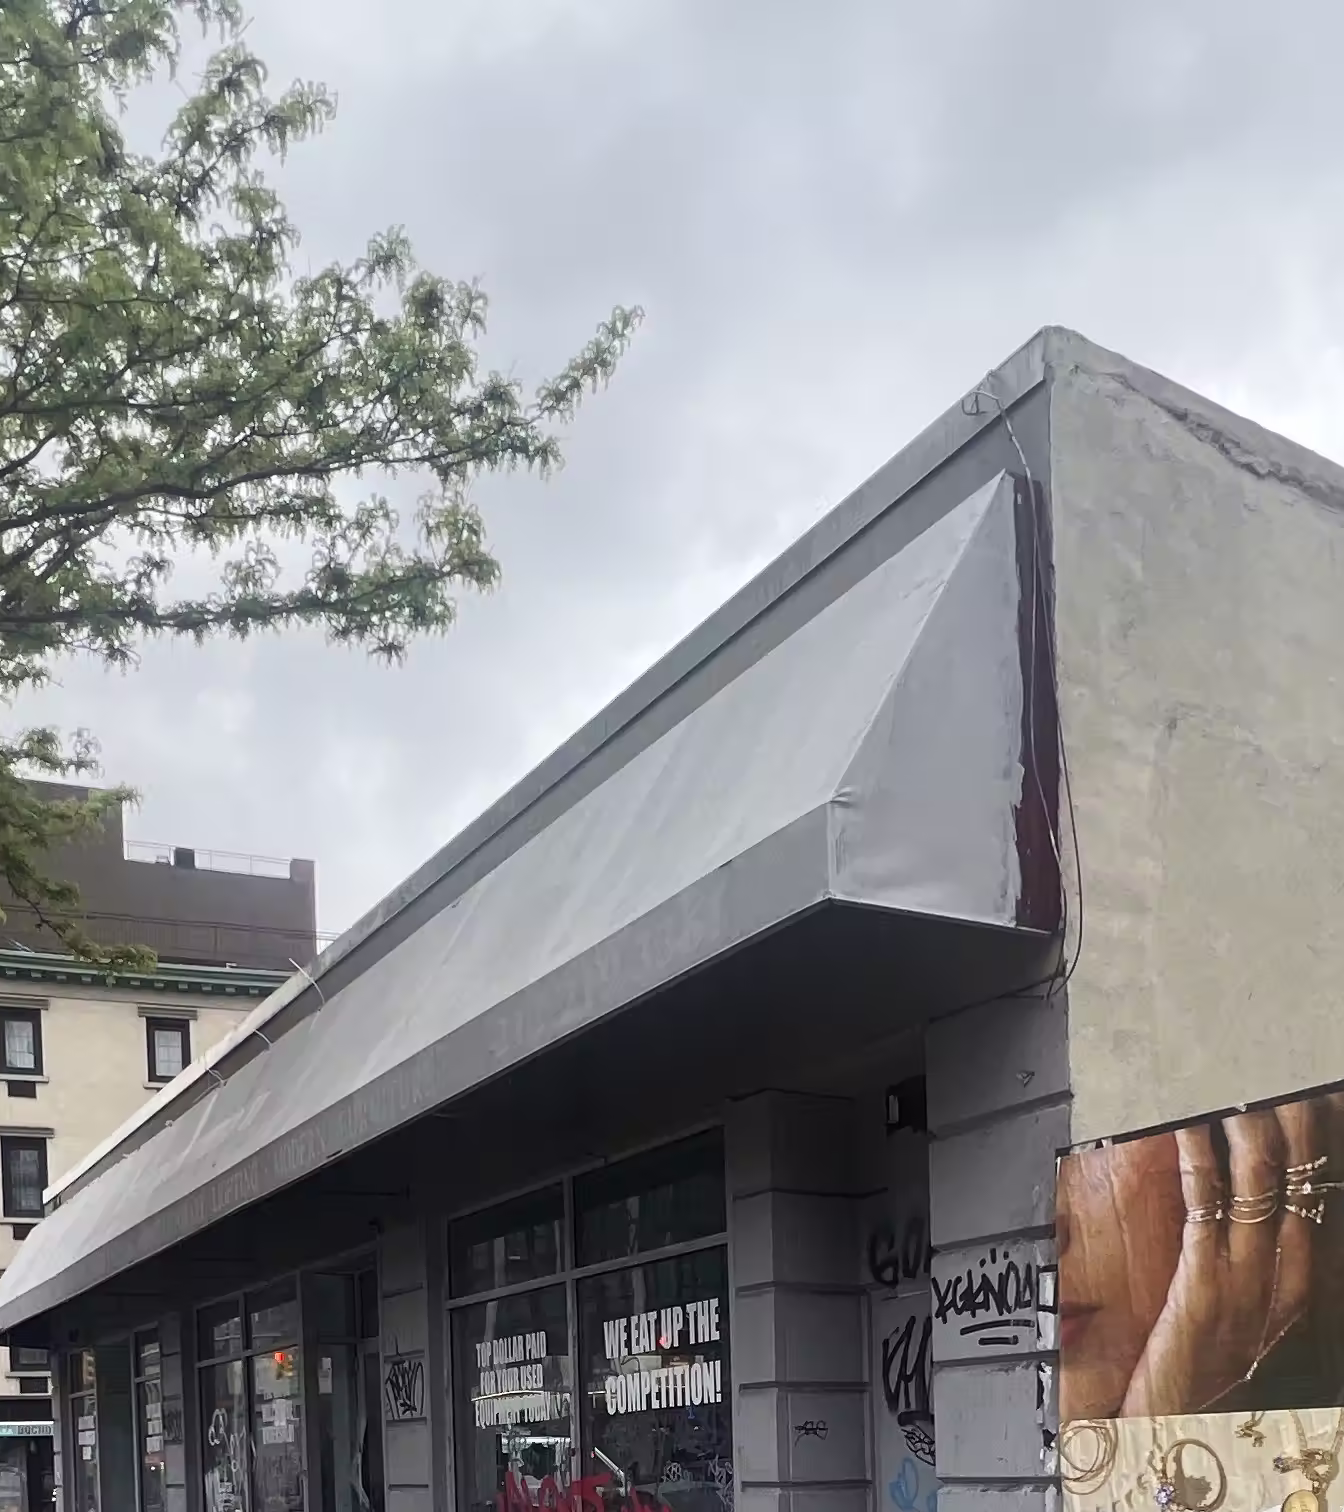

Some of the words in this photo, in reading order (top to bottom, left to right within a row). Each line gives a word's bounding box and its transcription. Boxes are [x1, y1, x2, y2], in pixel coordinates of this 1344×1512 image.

[476, 1342, 492, 1368] TOP
[493, 1335, 524, 1365] DOLLAR
[525, 1331, 546, 1360] PAID
[603, 1318, 628, 1359] WE
[630, 1311, 657, 1354] EAT
[660, 1306, 683, 1349] UP
[686, 1298, 720, 1344] THE
[480, 1371, 496, 1396] FOR
[496, 1367, 519, 1393] YOUR
[519, 1364, 543, 1390] USED
[604, 1360, 722, 1415] COMPETITION!
